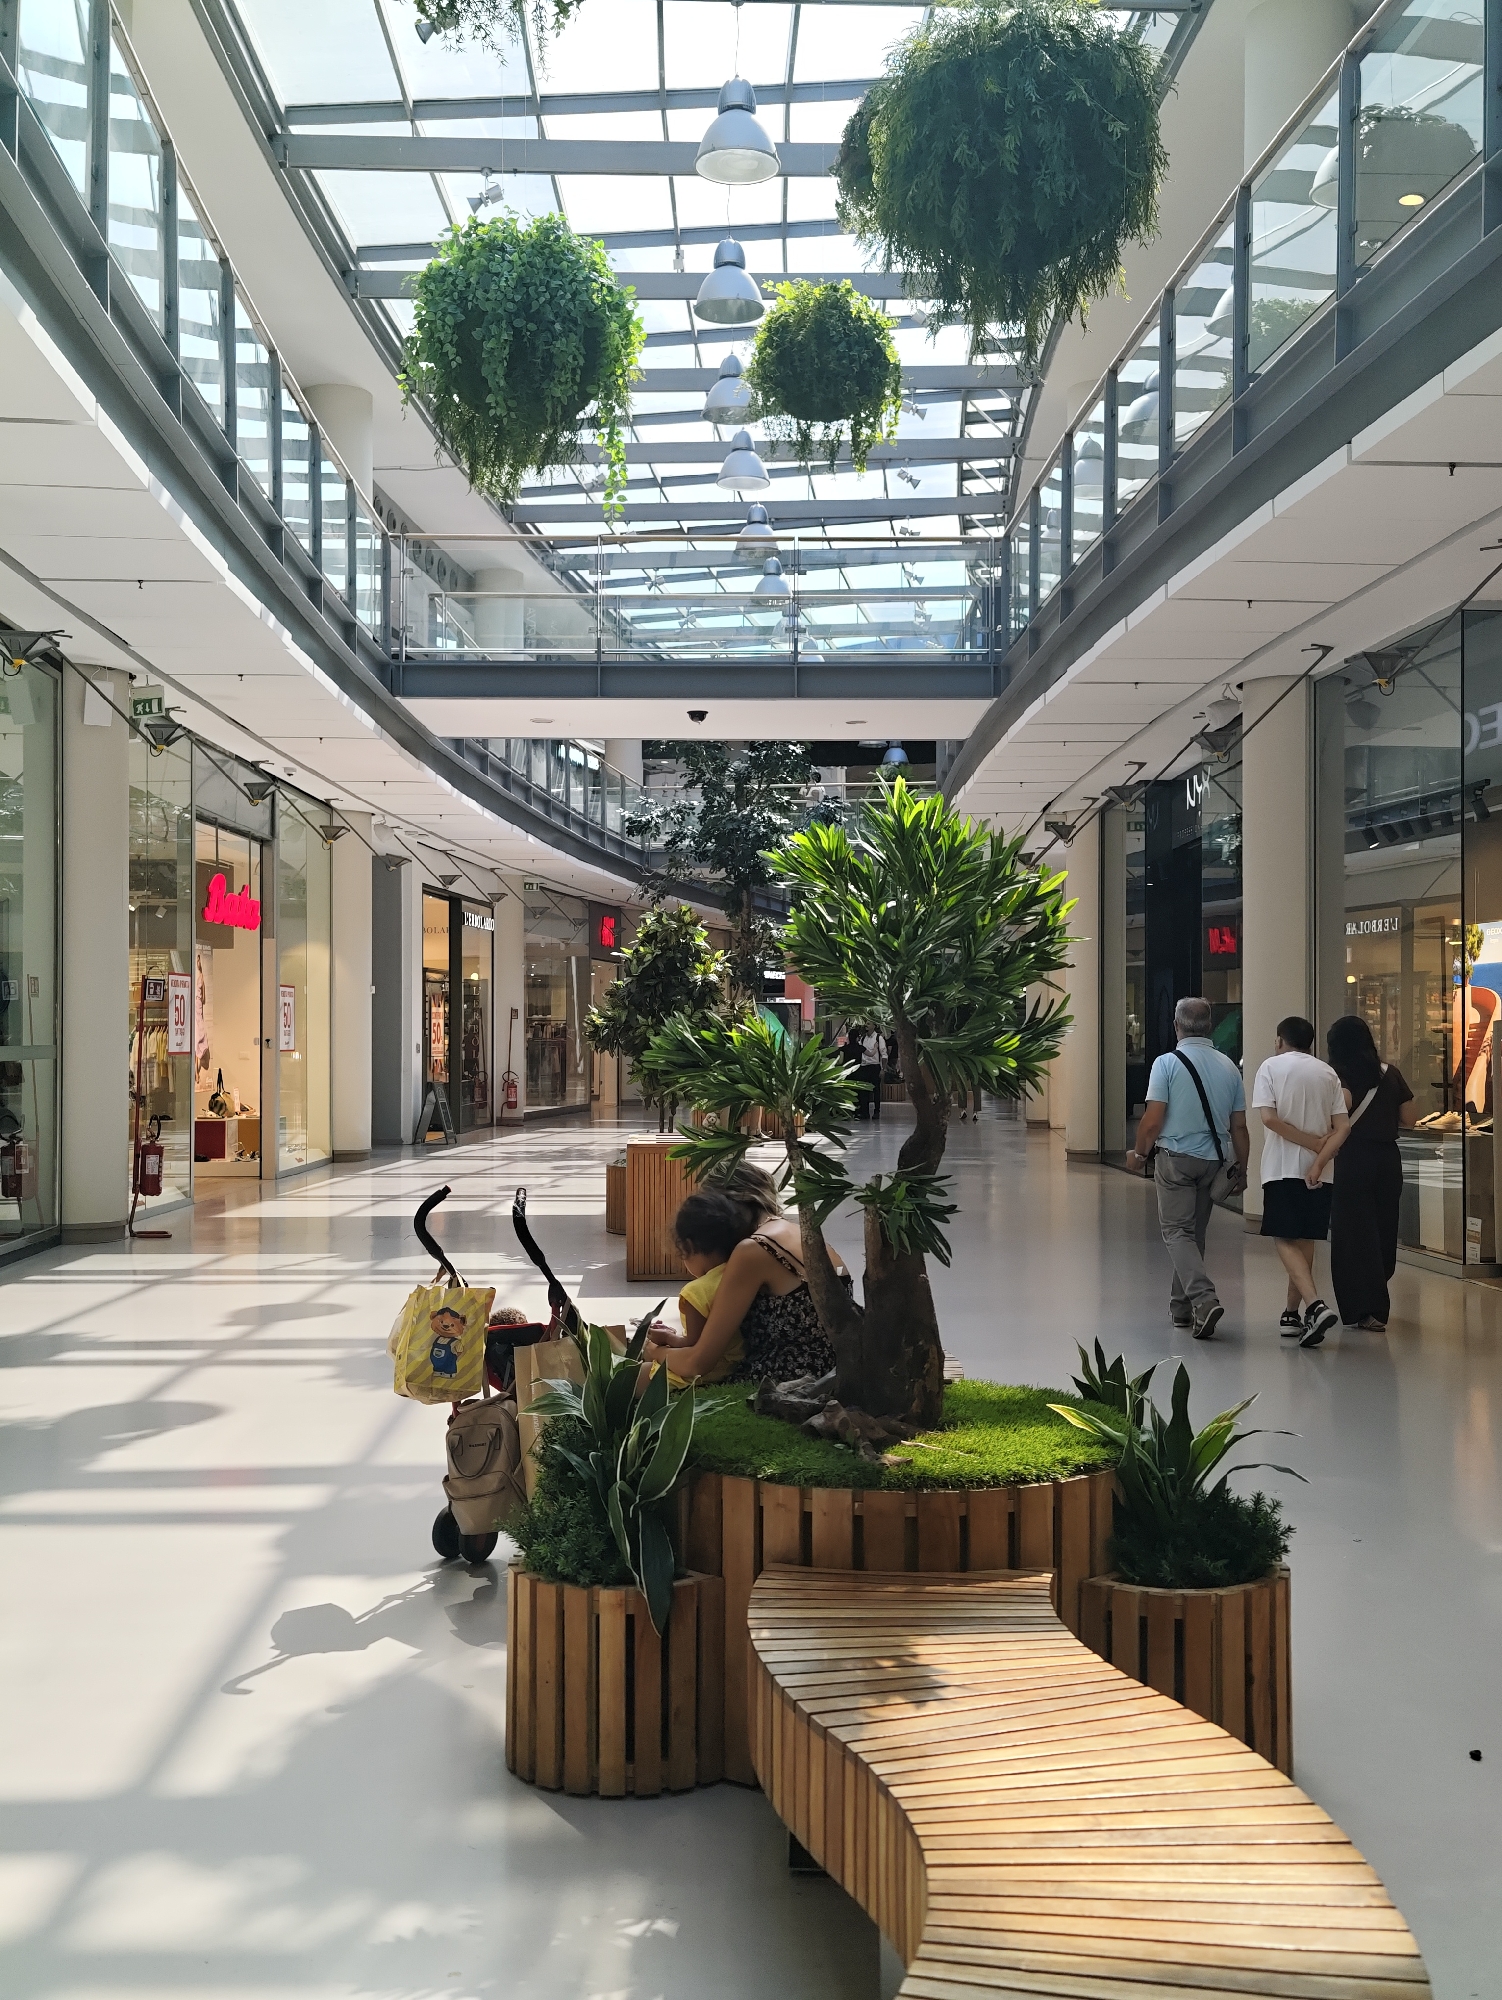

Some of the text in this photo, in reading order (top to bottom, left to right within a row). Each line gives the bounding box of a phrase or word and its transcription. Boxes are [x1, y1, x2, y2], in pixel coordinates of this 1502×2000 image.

[1186, 765, 1211, 810] NYX
[203, 873, 261, 931] Bata
[174, 994, 186, 1027] 50
[283, 1002, 292, 1029] 50
